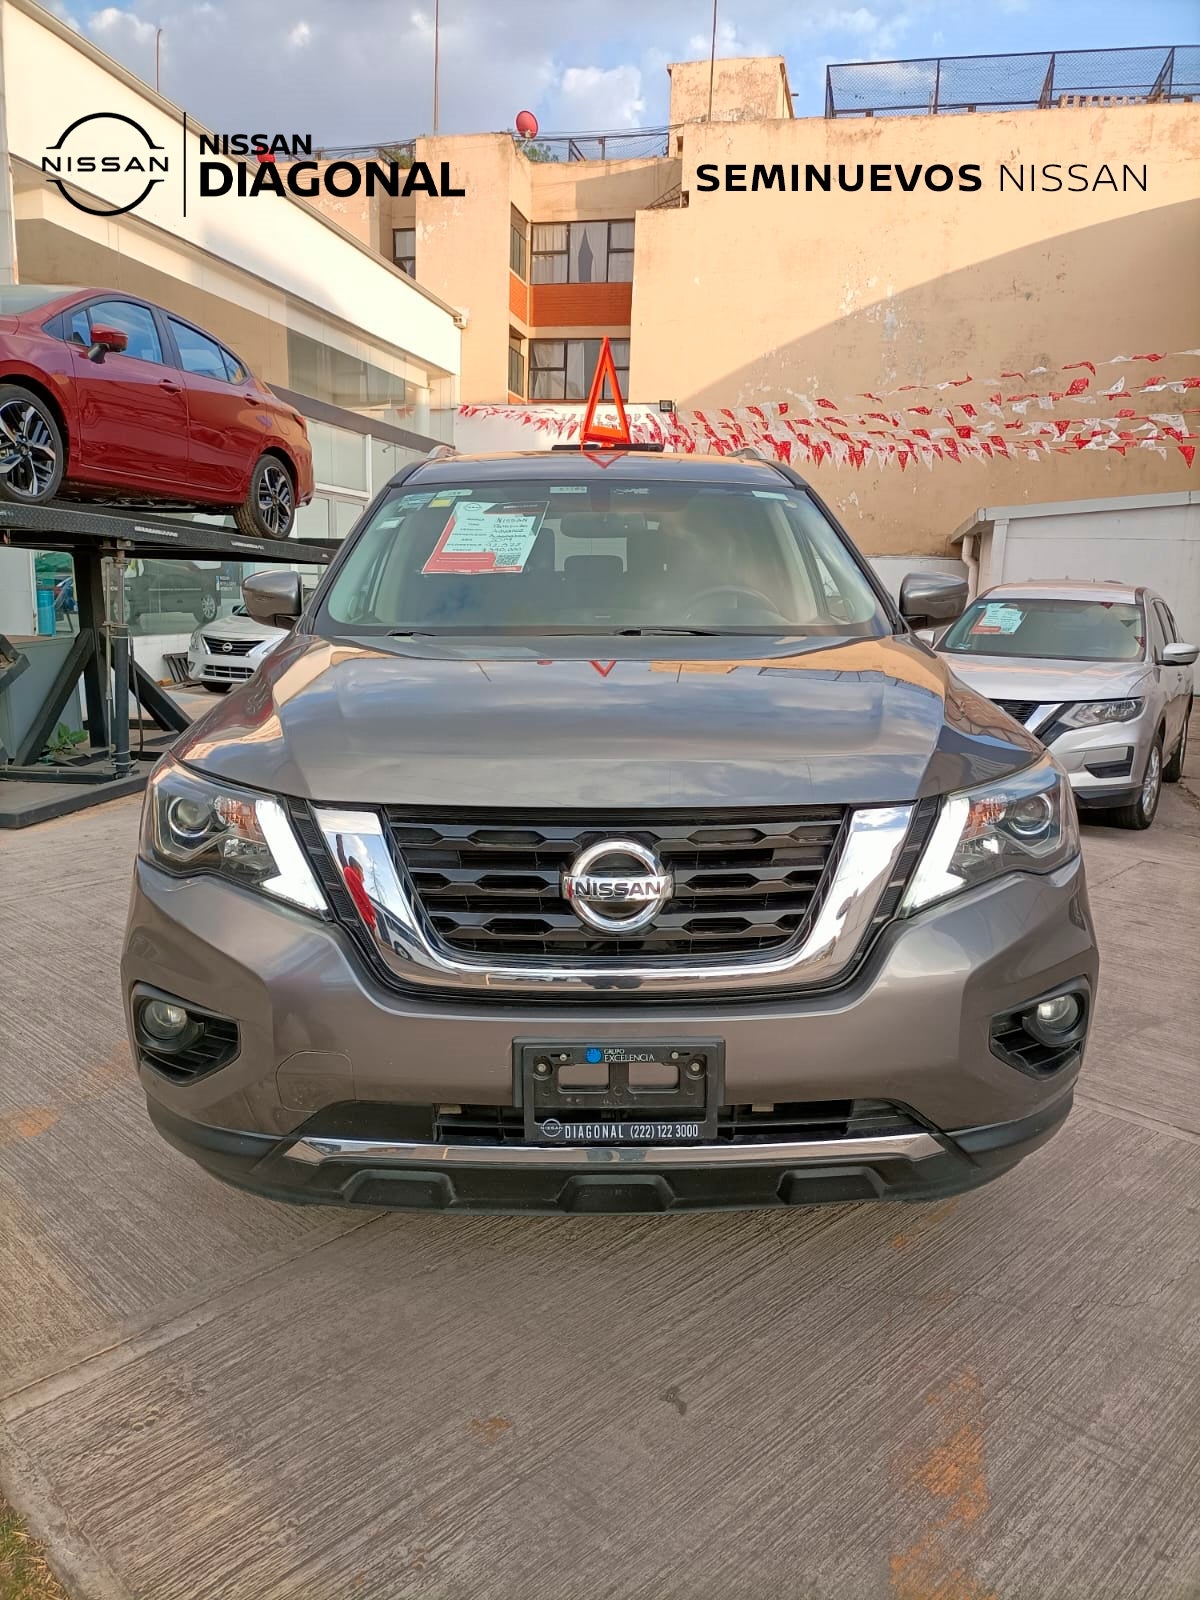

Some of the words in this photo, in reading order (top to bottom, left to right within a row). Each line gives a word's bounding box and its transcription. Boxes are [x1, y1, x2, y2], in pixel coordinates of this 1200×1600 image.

[575, 880, 661, 897] NISSAN
[604, 1054, 655, 1063] EXCELENCIA
[564, 1124, 624, 1139] DIAGONAL
[630, 1124, 655, 1139] (222)
[657, 1125, 673, 1138] 122
[675, 1124, 699, 1138] 3000
